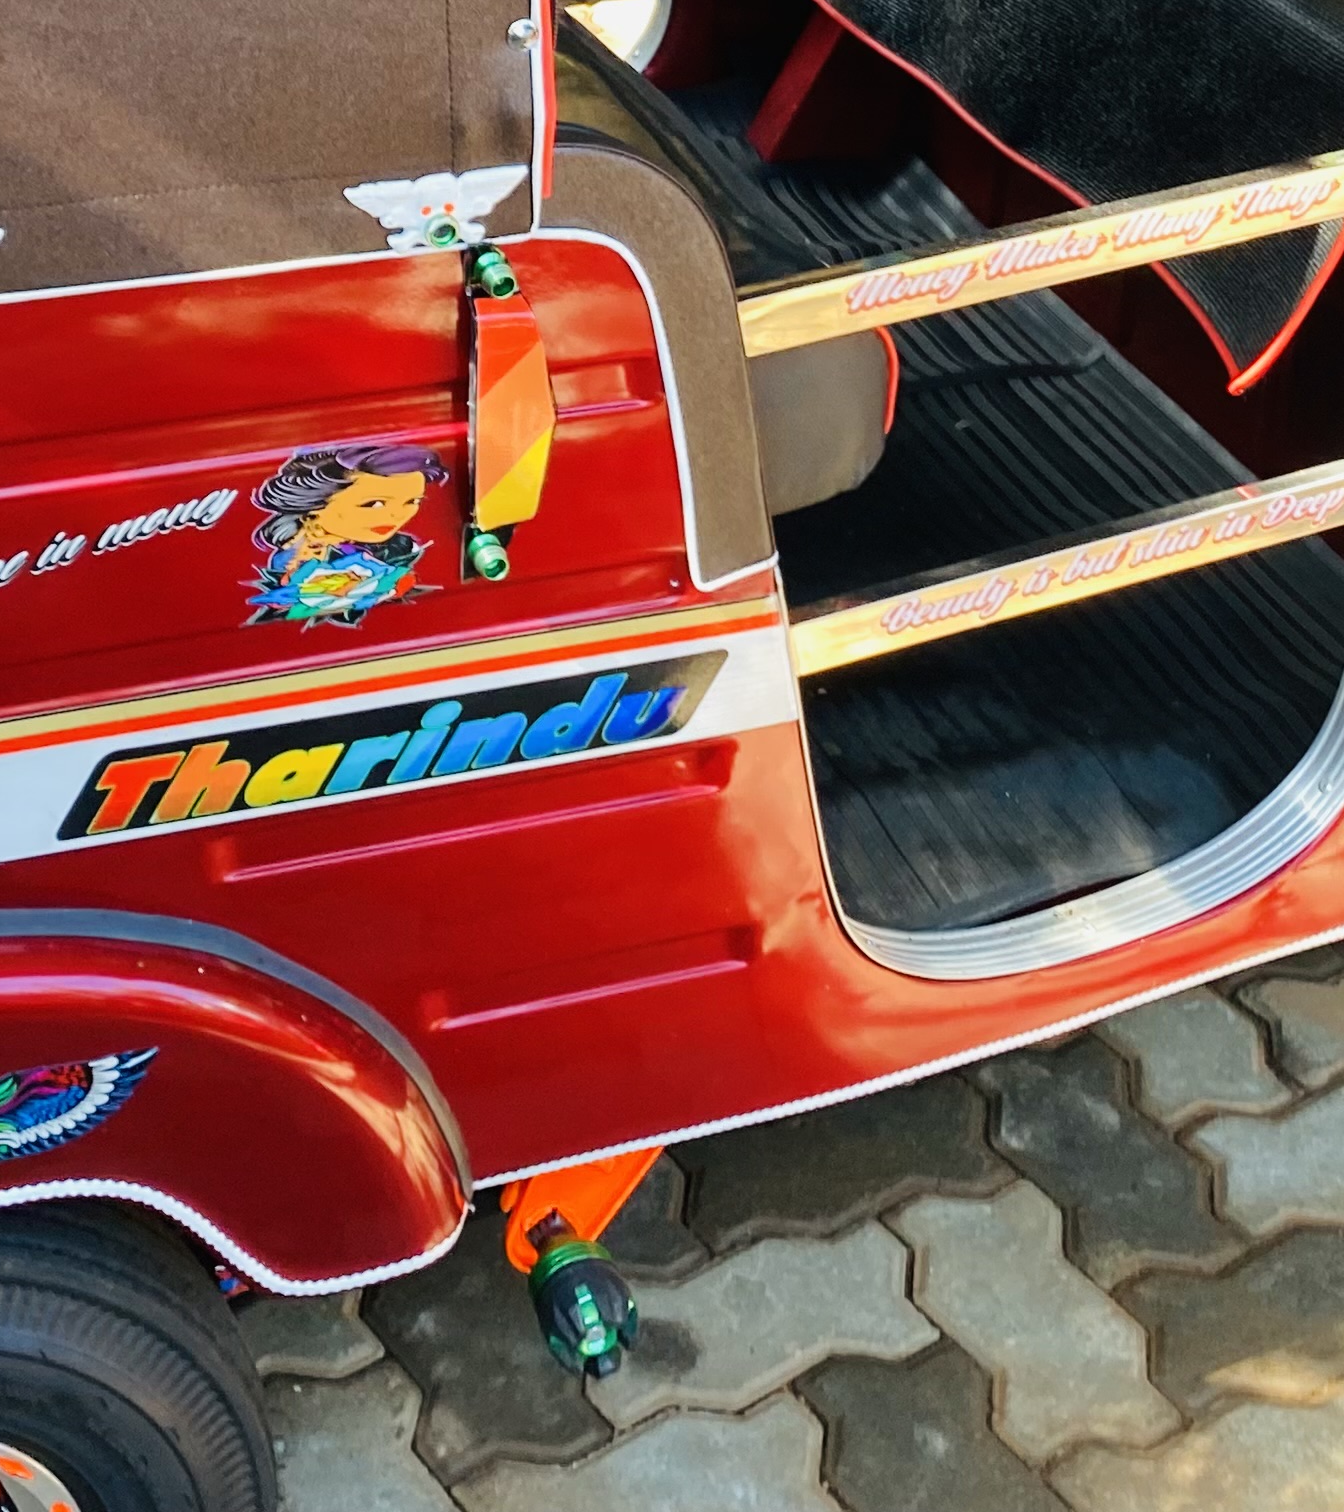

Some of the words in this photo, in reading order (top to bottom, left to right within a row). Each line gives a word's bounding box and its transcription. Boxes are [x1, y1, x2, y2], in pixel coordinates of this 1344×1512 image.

[845, 260, 978, 314] Money
[984, 229, 1108, 280] Makes
[1112, 204, 1225, 252] Many
[1228, 178, 1342, 225] Things
[29, 532, 87, 576] in
[91, 488, 239, 556] money
[880, 574, 1019, 635] Beauty
[1021, 563, 1058, 598] is
[1060, 538, 1132, 585] but
[1129, 524, 1212, 569] skin
[1212, 510, 1257, 543] in
[86, 671, 689, 836] Tharindu
